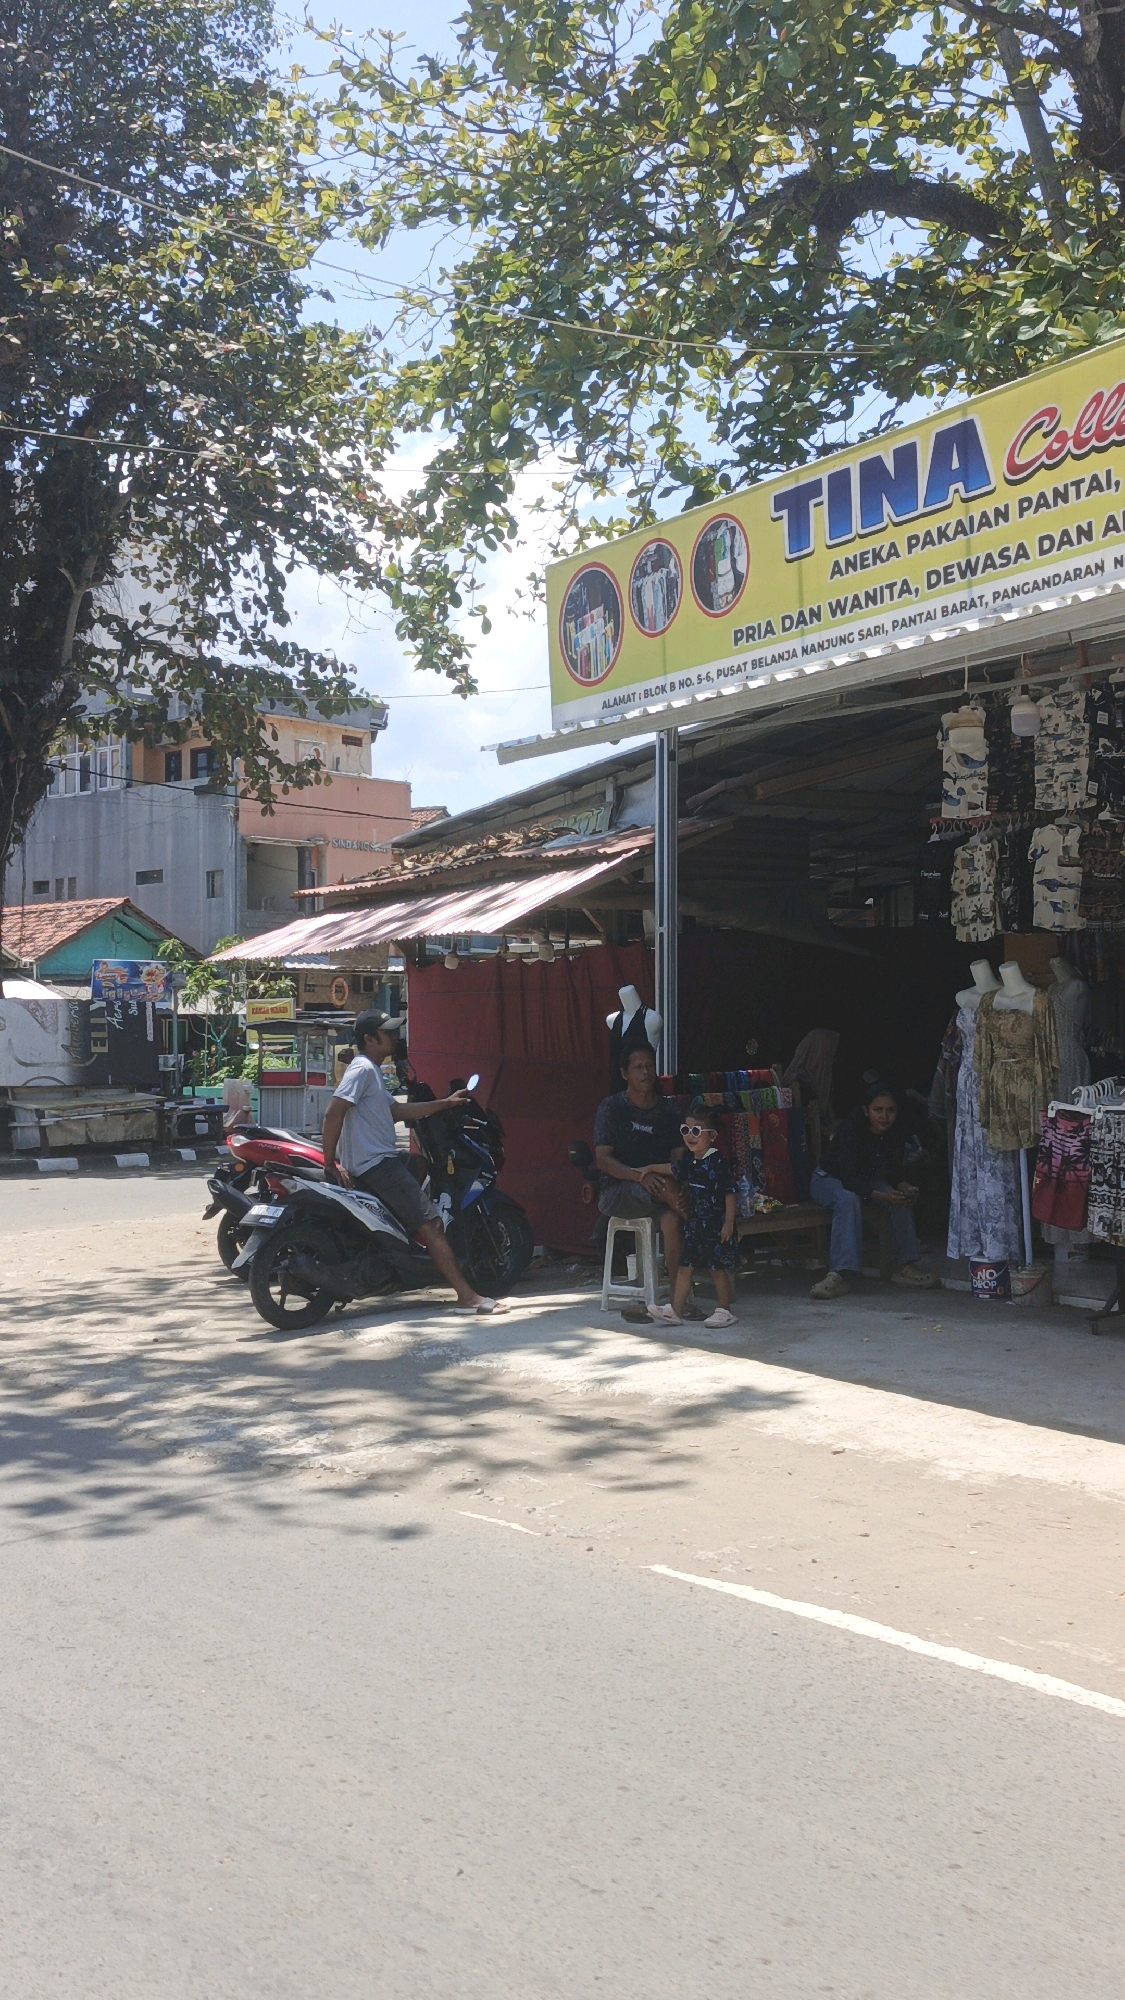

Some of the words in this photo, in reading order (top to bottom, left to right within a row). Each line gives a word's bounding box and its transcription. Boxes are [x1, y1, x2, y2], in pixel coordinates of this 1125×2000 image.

[771, 415, 995, 561] TINA
[829, 541, 901, 580] ANEKA
[907, 503, 1009, 554] PAKAIAN
[1018, 468, 1120, 519] PANTAI,
[602, 692, 636, 710] ALAMAT
[643, 682, 668, 699] BLOK
[669, 681, 676, 692] B
[678, 677, 695, 690] NO.
[696, 673, 714, 685] 5-6,
[716, 661, 748, 680] PUSAT
[751, 649, 798, 670] BELANJA
[801, 632, 855, 657] NANJUNG
[858, 623, 888, 641] SARI,
[891, 608, 937, 632] PANTAI
[941, 595, 988, 618] BARAT,
[992, 559, 1105, 602] PANGANDARAN
[733, 619, 776, 647] PRIA
[781, 604, 821, 633] DAN
[828, 578, 919, 619] WANITA,
[926, 542, 1031, 590] DEWASA
[1038, 521, 1094, 556] DAN
[1102, 509, 1125, 539] A
[972, 1279, 997, 1289] DROP
[976, 1268, 997, 1281] NO
